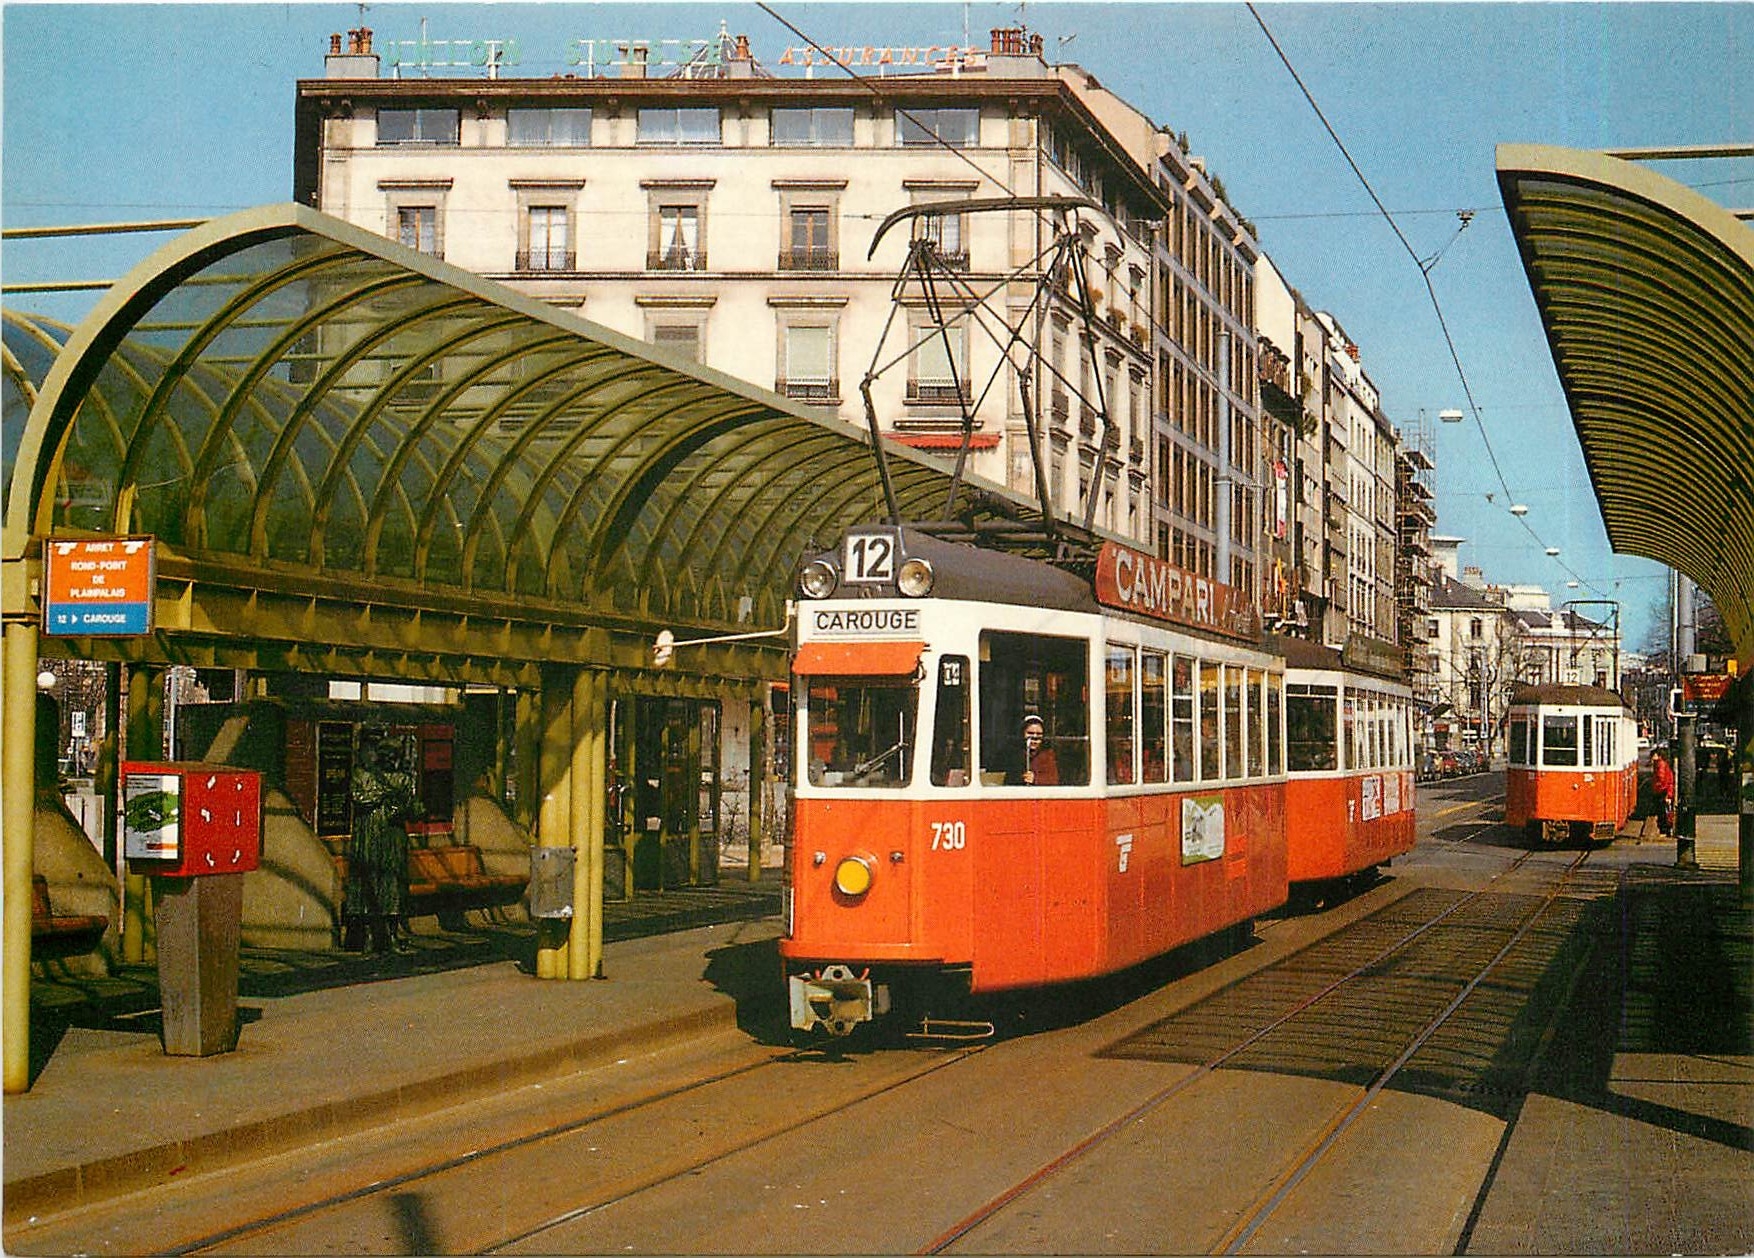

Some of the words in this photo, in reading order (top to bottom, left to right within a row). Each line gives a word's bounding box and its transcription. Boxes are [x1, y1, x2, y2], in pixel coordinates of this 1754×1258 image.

[778, 45, 983, 66] ASSURANCES
[852, 537, 891, 578] 12
[70, 560, 128, 571] ROND-POINT
[92, 575, 105, 584] DE
[70, 588, 126, 598] PLAINPALAIS
[57, 614, 67, 624] 12
[83, 614, 126, 624] CAROUGE
[816, 610, 918, 630] CAROUGE
[1566, 671, 1579, 683] 12
[931, 821, 966, 850] 730
